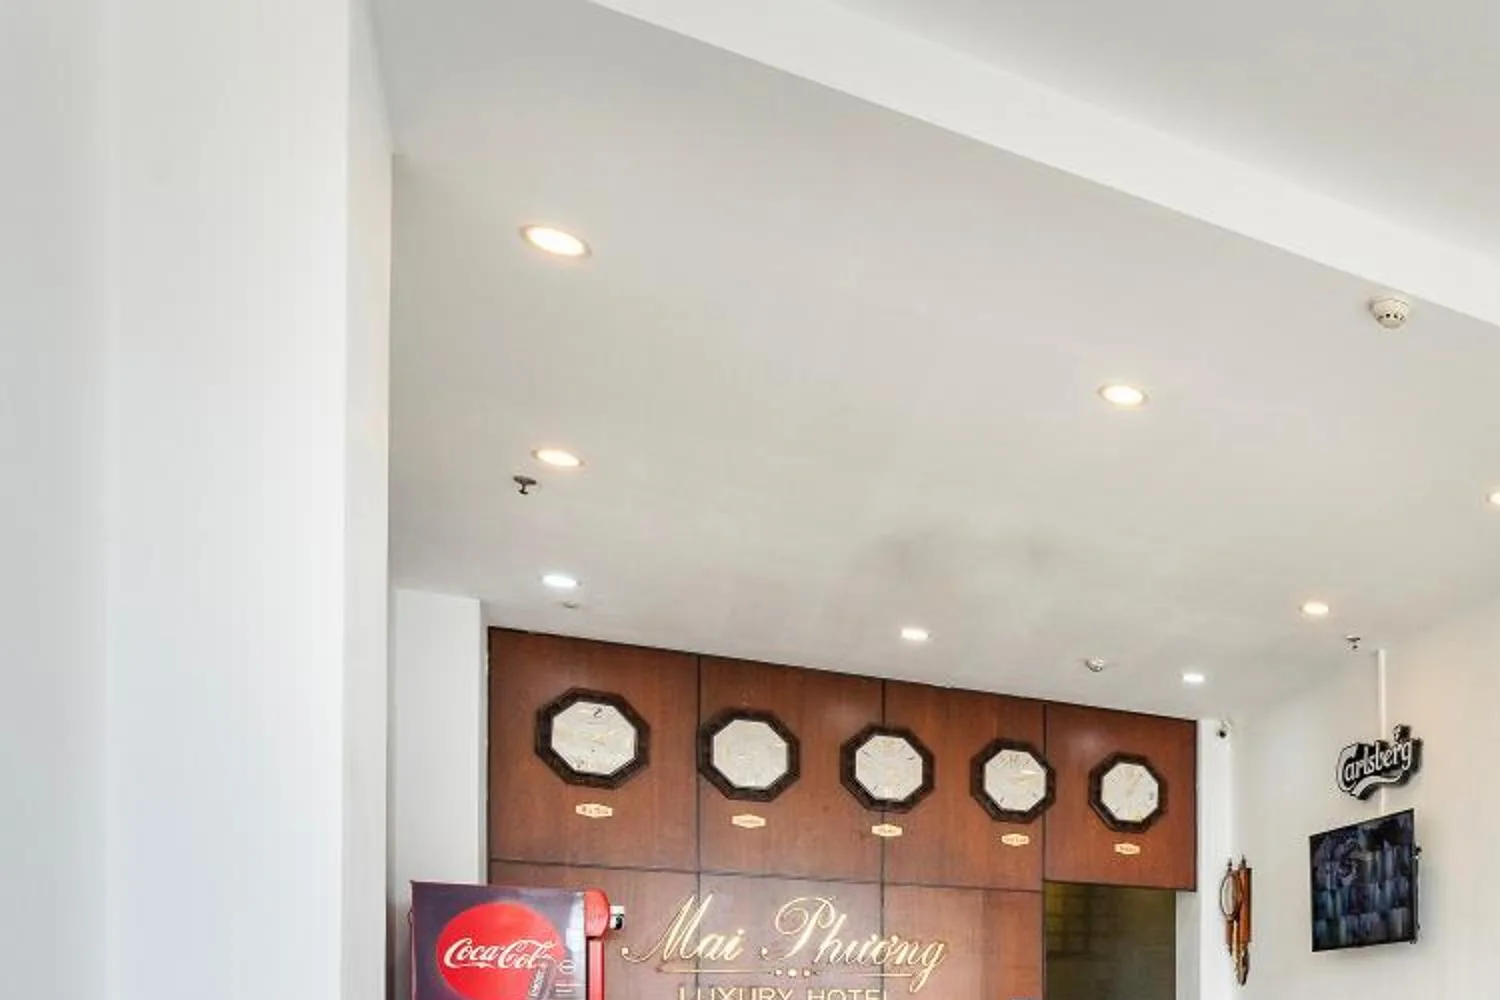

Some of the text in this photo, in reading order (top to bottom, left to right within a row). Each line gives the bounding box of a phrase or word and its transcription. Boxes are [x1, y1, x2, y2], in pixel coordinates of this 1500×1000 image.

[1337, 740, 1412, 791] Carlsberg
[621, 893, 946, 993] Mai Phương
